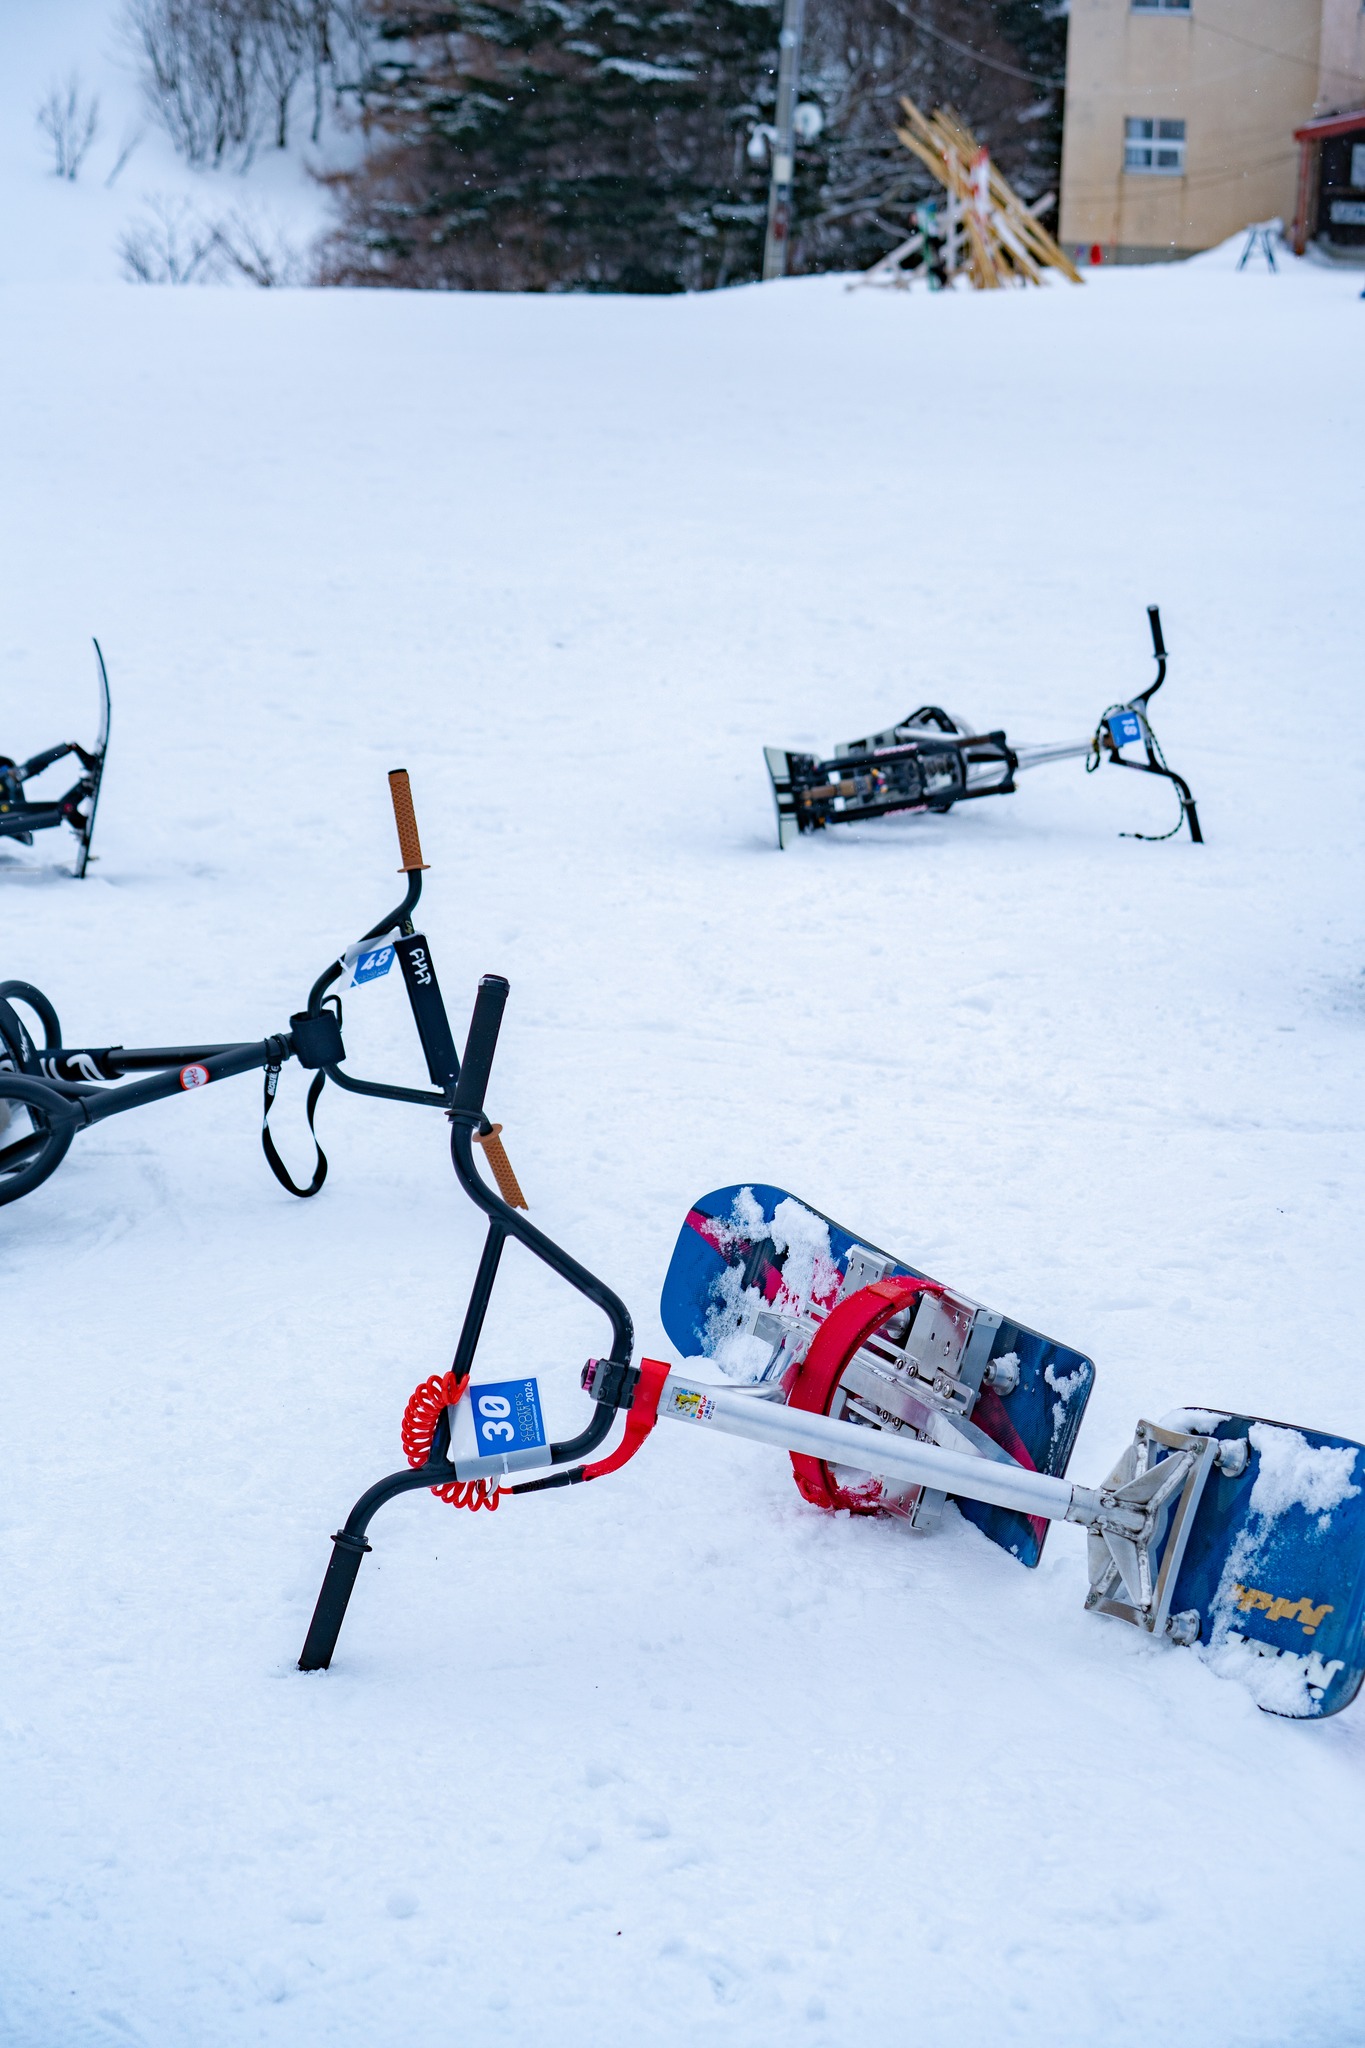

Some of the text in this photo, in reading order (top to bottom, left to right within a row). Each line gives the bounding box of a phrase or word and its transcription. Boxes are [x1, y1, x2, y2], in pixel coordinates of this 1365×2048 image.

[361, 948, 392, 971] 48
[409, 948, 431, 985] CULT
[524, 1381, 535, 1403] 2026
[478, 1395, 515, 1442] 30
[514, 1392, 529, 1443] SCOOTER'S
